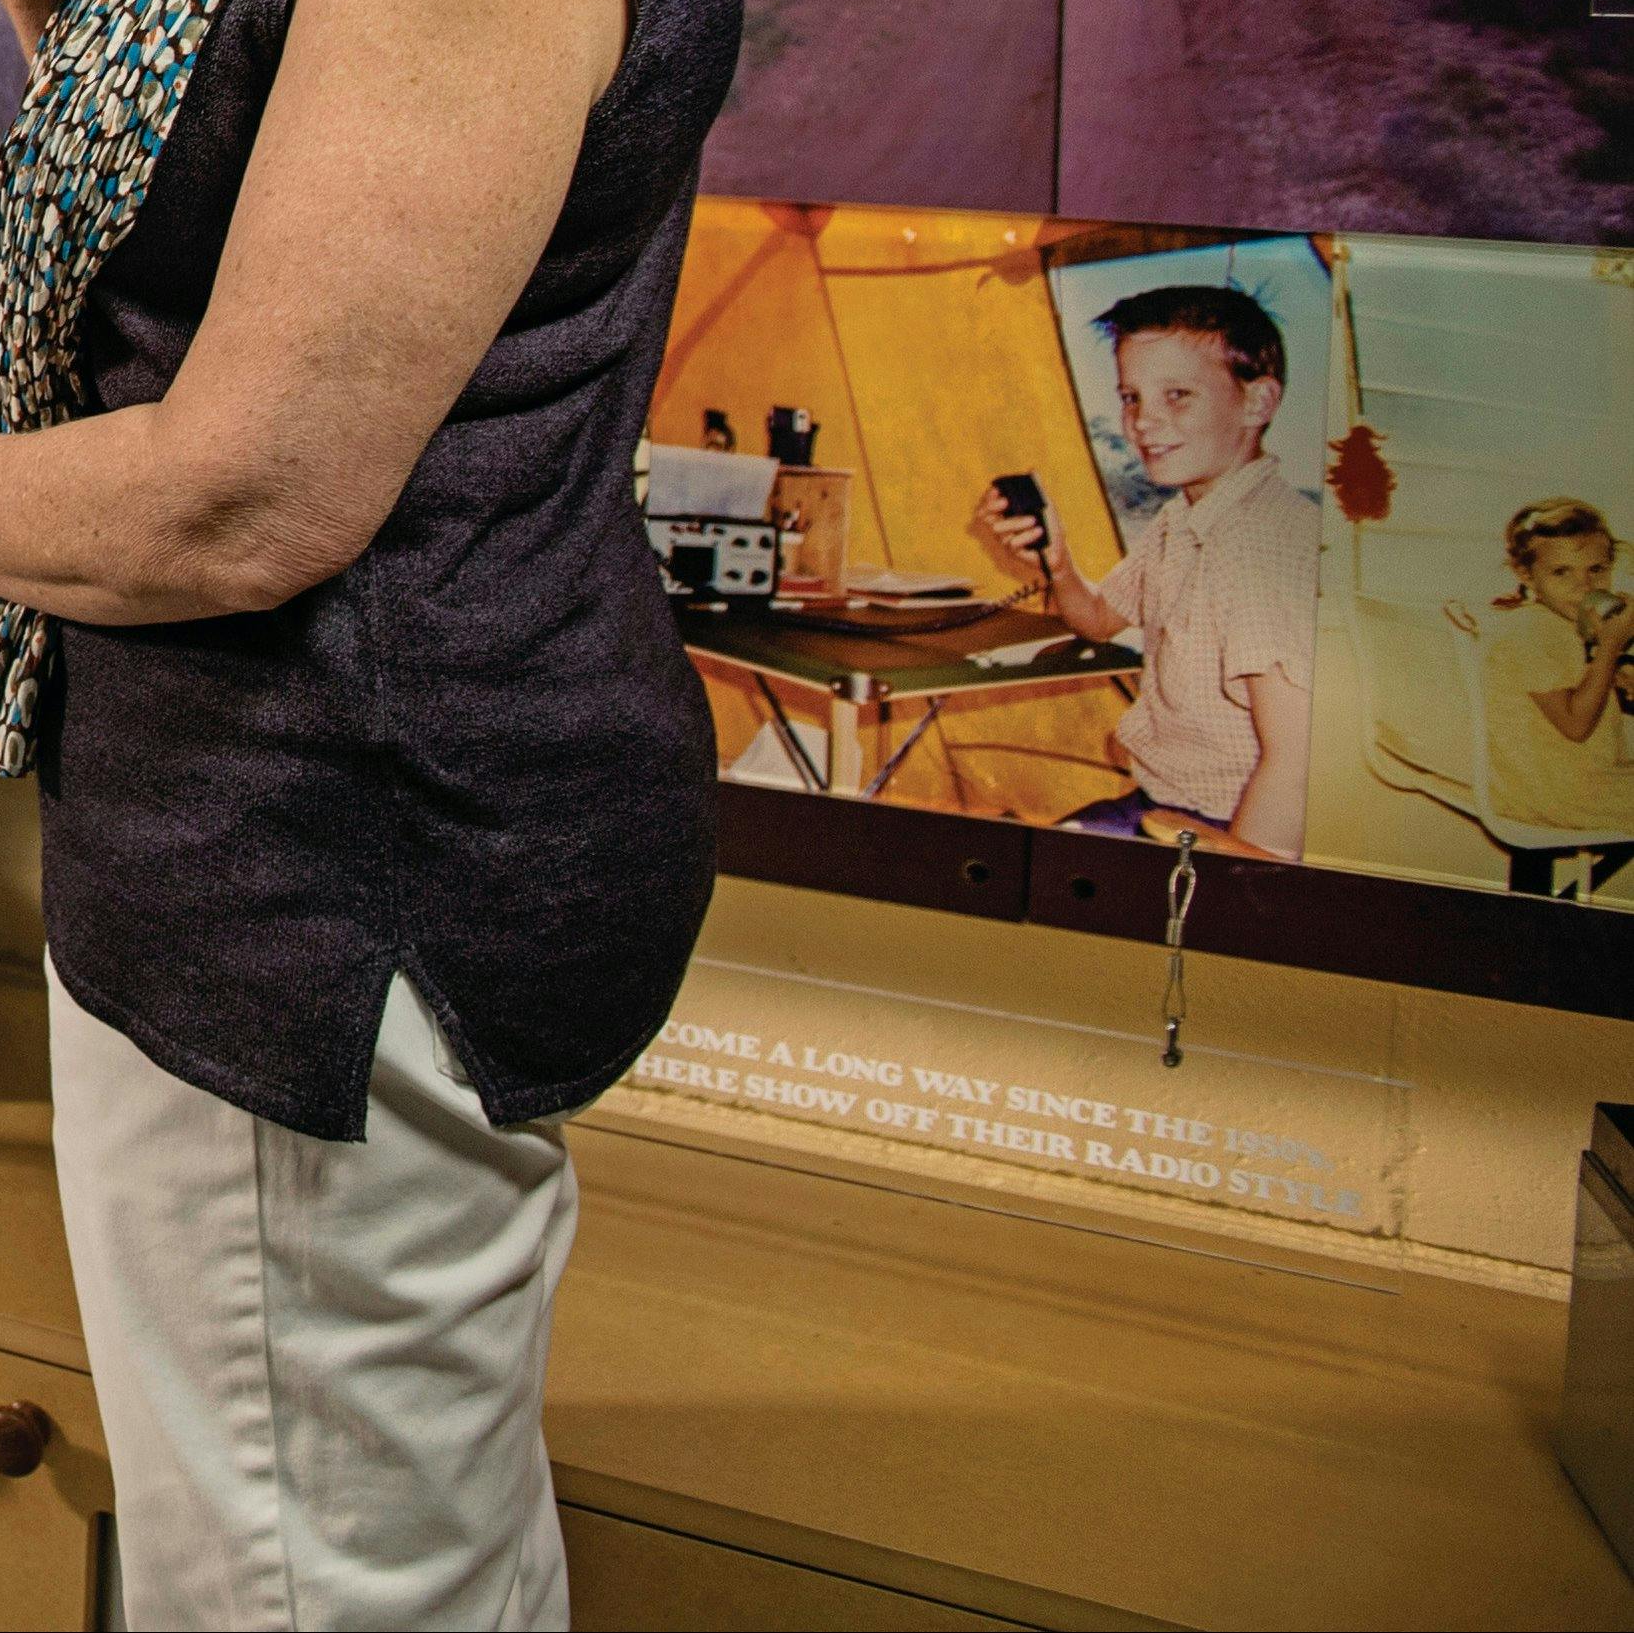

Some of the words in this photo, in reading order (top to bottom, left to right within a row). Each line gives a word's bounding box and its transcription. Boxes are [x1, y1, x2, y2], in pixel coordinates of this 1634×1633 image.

[660, 1020, 761, 1061] COME
[768, 1040, 796, 1068] A
[803, 1047, 904, 1088] LONG
[911, 1066, 1001, 1106] WAY
[1006, 1085, 1118, 1130] SINCE
[1124, 1108, 1216, 1148] THE
[745, 1075, 858, 1116] SHOW
[865, 1097, 940, 1136] OFF
[946, 1113, 1077, 1161] THEIR
[1084, 1139, 1221, 1189] RADIO
[1227, 1167, 1365, 1219] STYLE
